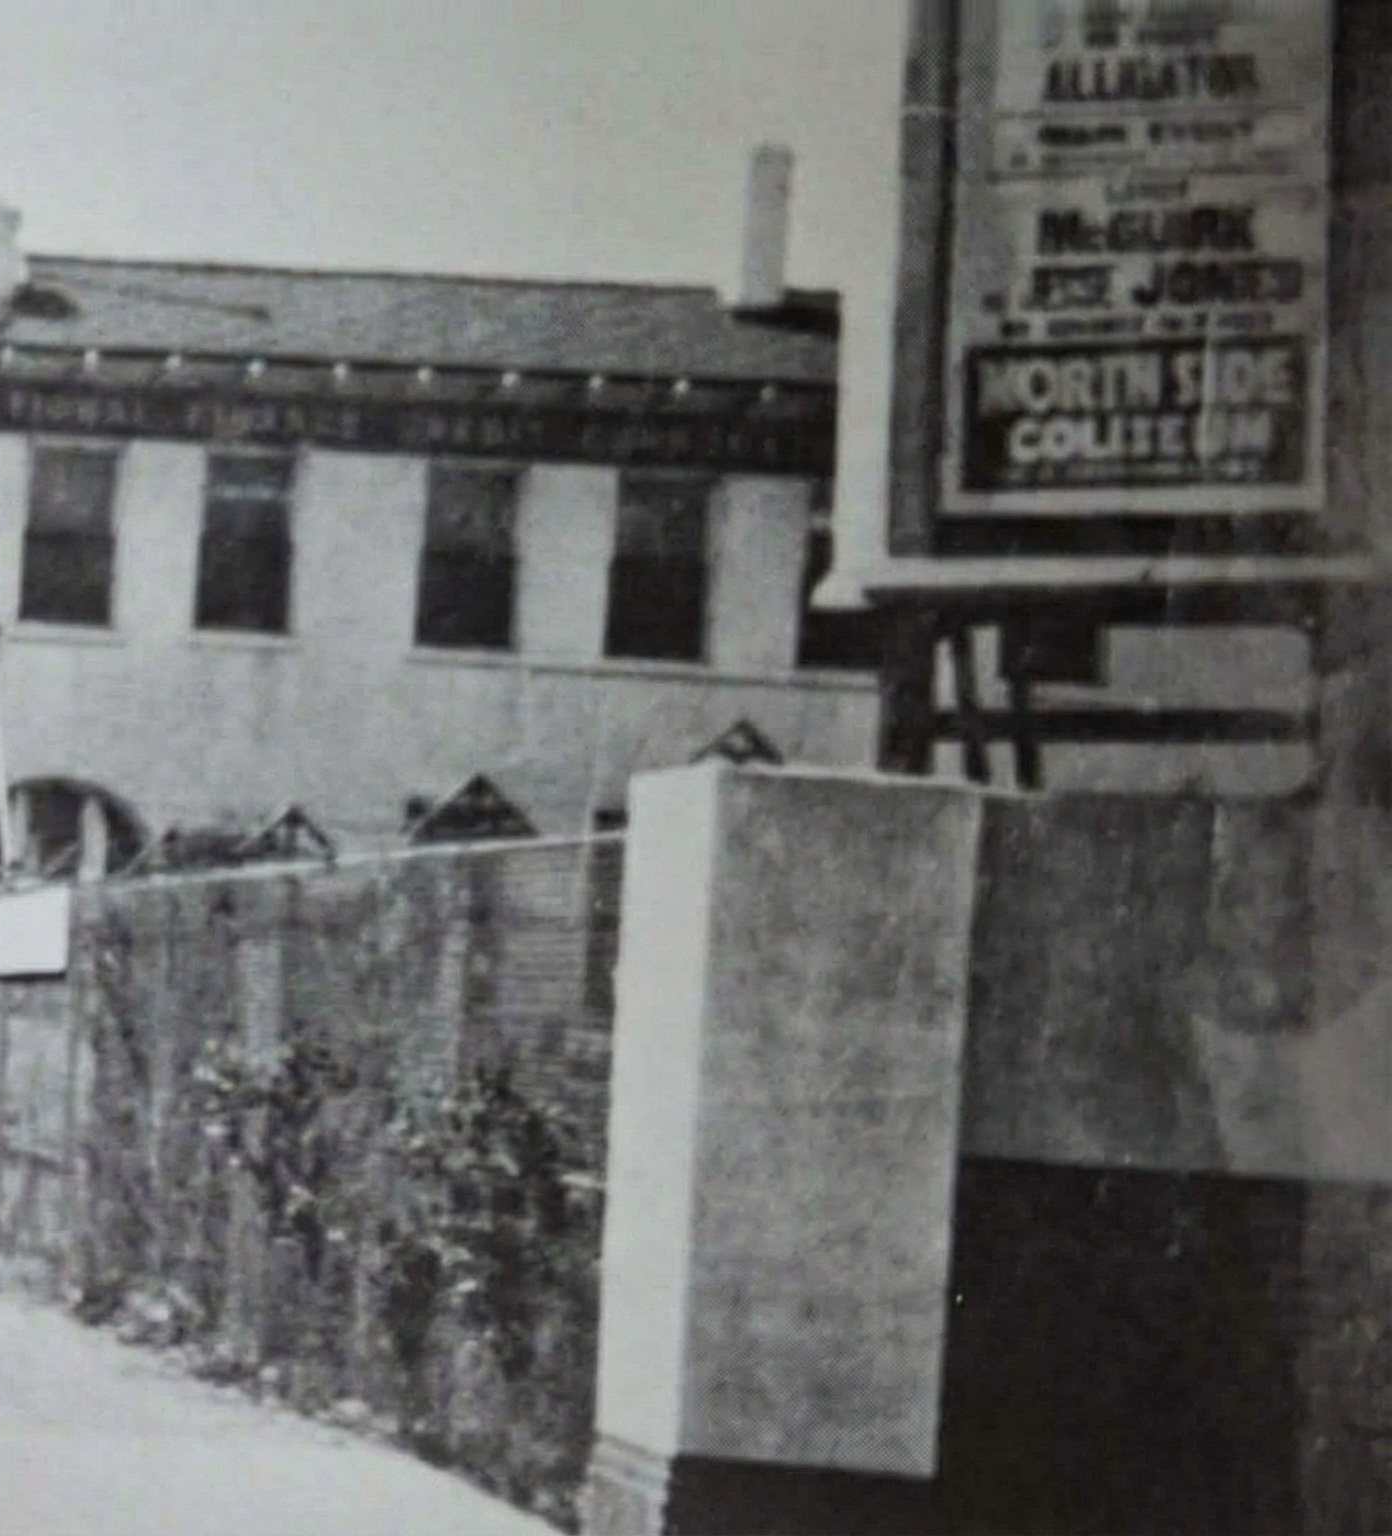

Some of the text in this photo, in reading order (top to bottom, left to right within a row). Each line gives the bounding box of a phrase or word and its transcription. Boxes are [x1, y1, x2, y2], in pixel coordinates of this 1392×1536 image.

[1040, 53, 1261, 101] ALLIGATOR
[977, 346, 1292, 413] NORTH SIDE
[1008, 409, 1274, 464] COLISEUM
